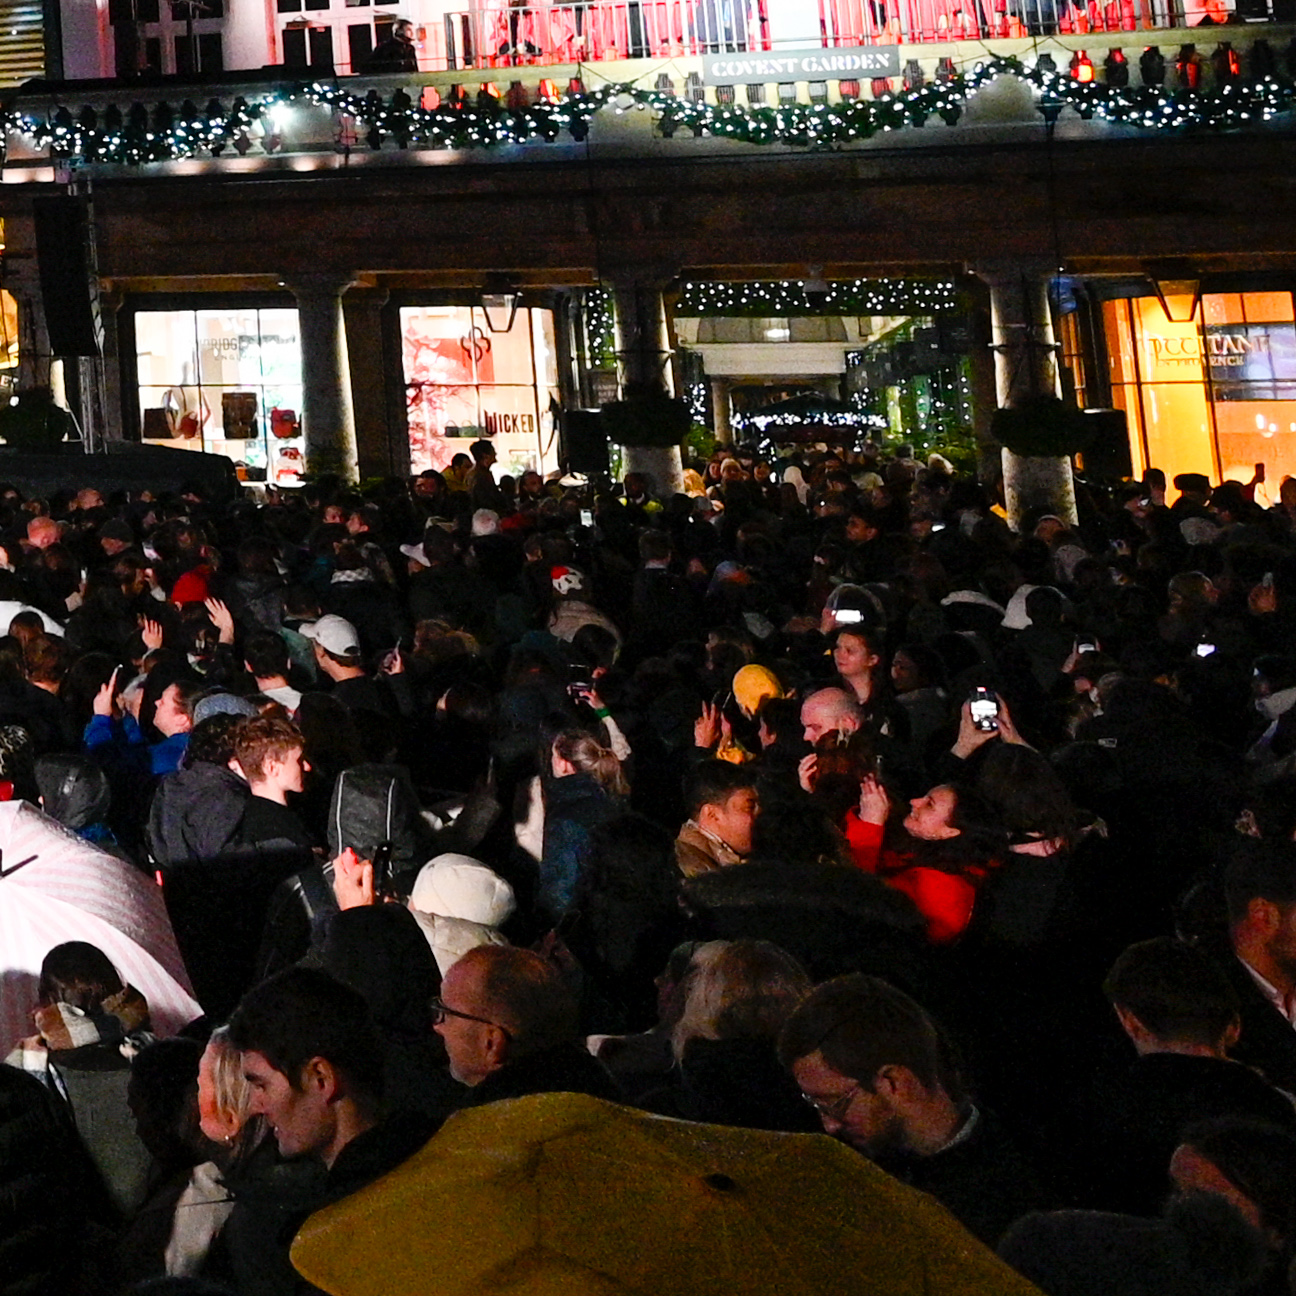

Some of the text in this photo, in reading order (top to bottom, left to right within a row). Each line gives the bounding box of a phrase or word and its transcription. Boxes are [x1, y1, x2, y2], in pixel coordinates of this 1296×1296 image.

[710, 52, 890, 77] COVENT GARDEN
[483, 409, 535, 436] WICKED
